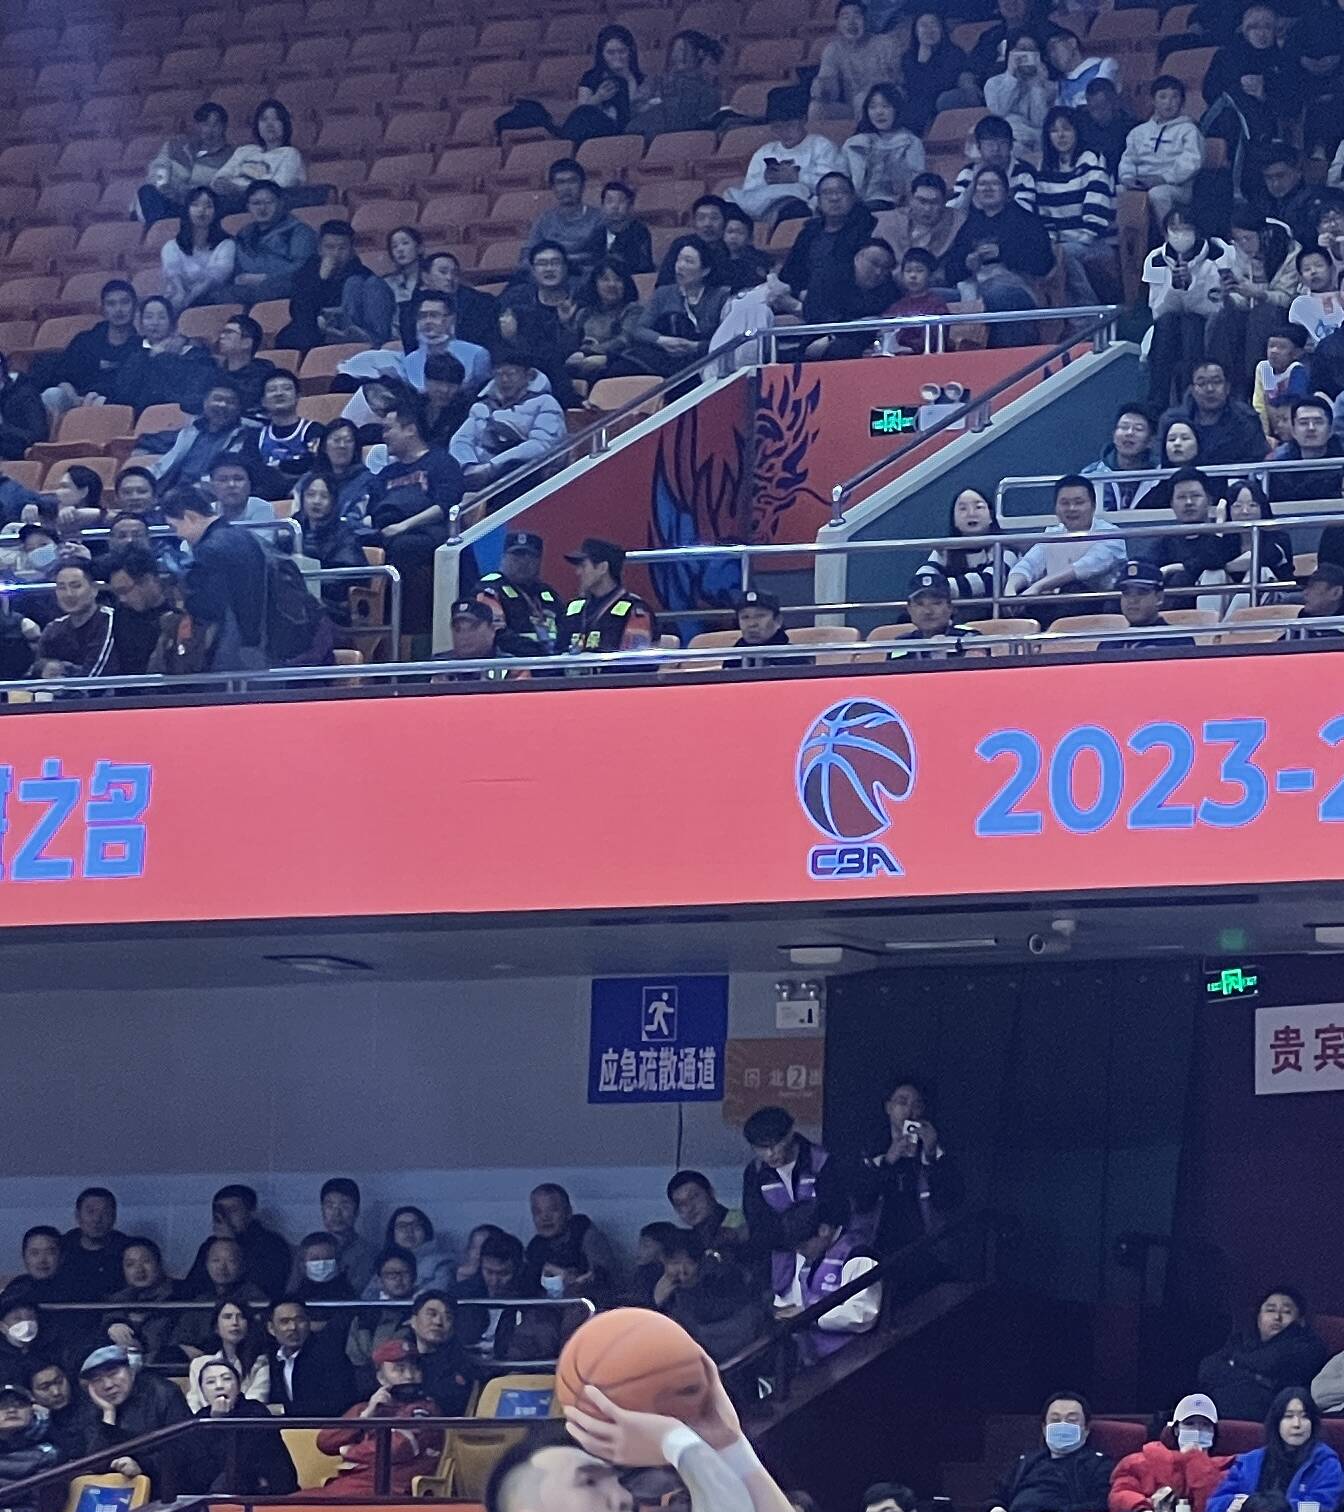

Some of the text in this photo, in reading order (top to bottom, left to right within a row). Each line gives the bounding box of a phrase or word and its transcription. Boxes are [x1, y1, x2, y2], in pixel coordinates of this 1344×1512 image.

[807, 843, 905, 880] CBA
[598, 1046, 716, 1093] 应急疏散通道
